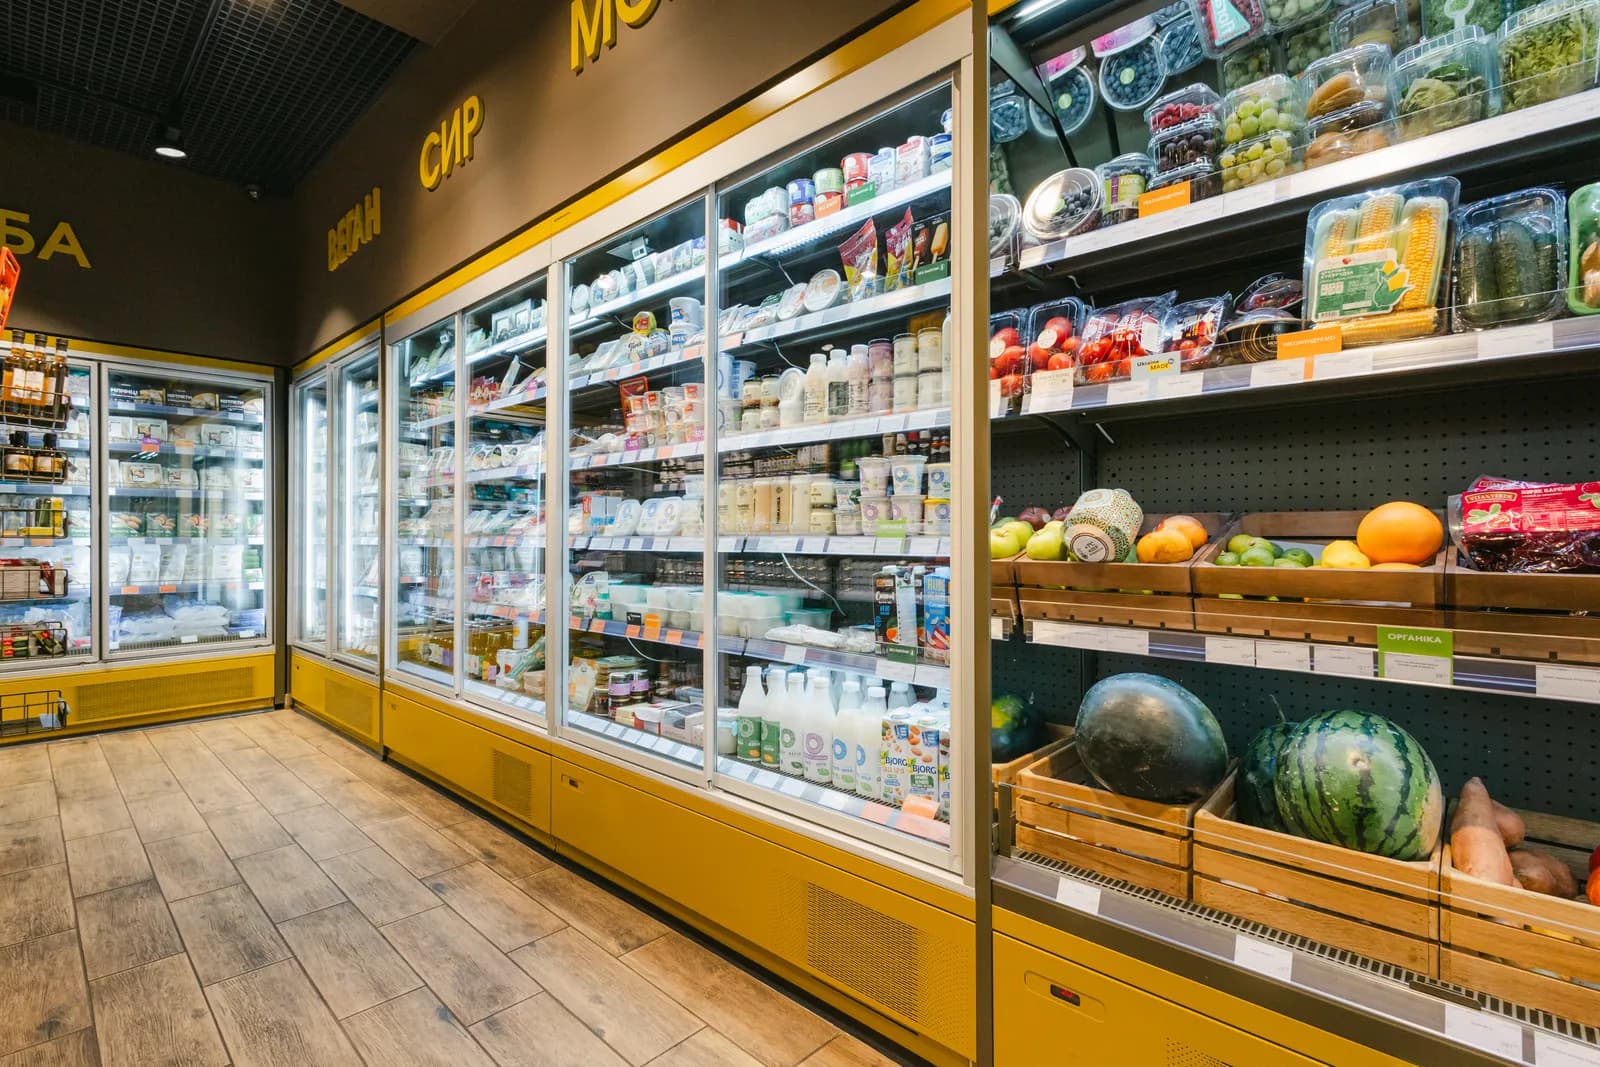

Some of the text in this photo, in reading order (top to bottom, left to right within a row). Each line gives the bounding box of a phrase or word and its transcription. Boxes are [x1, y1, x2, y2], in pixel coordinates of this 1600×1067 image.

[419, 95, 485, 190] СИР
[327, 186, 381, 271] ВЕГАН
[1149, 363, 1170, 371] MADE
[1387, 633, 1442, 644] ОРГАНІКА
